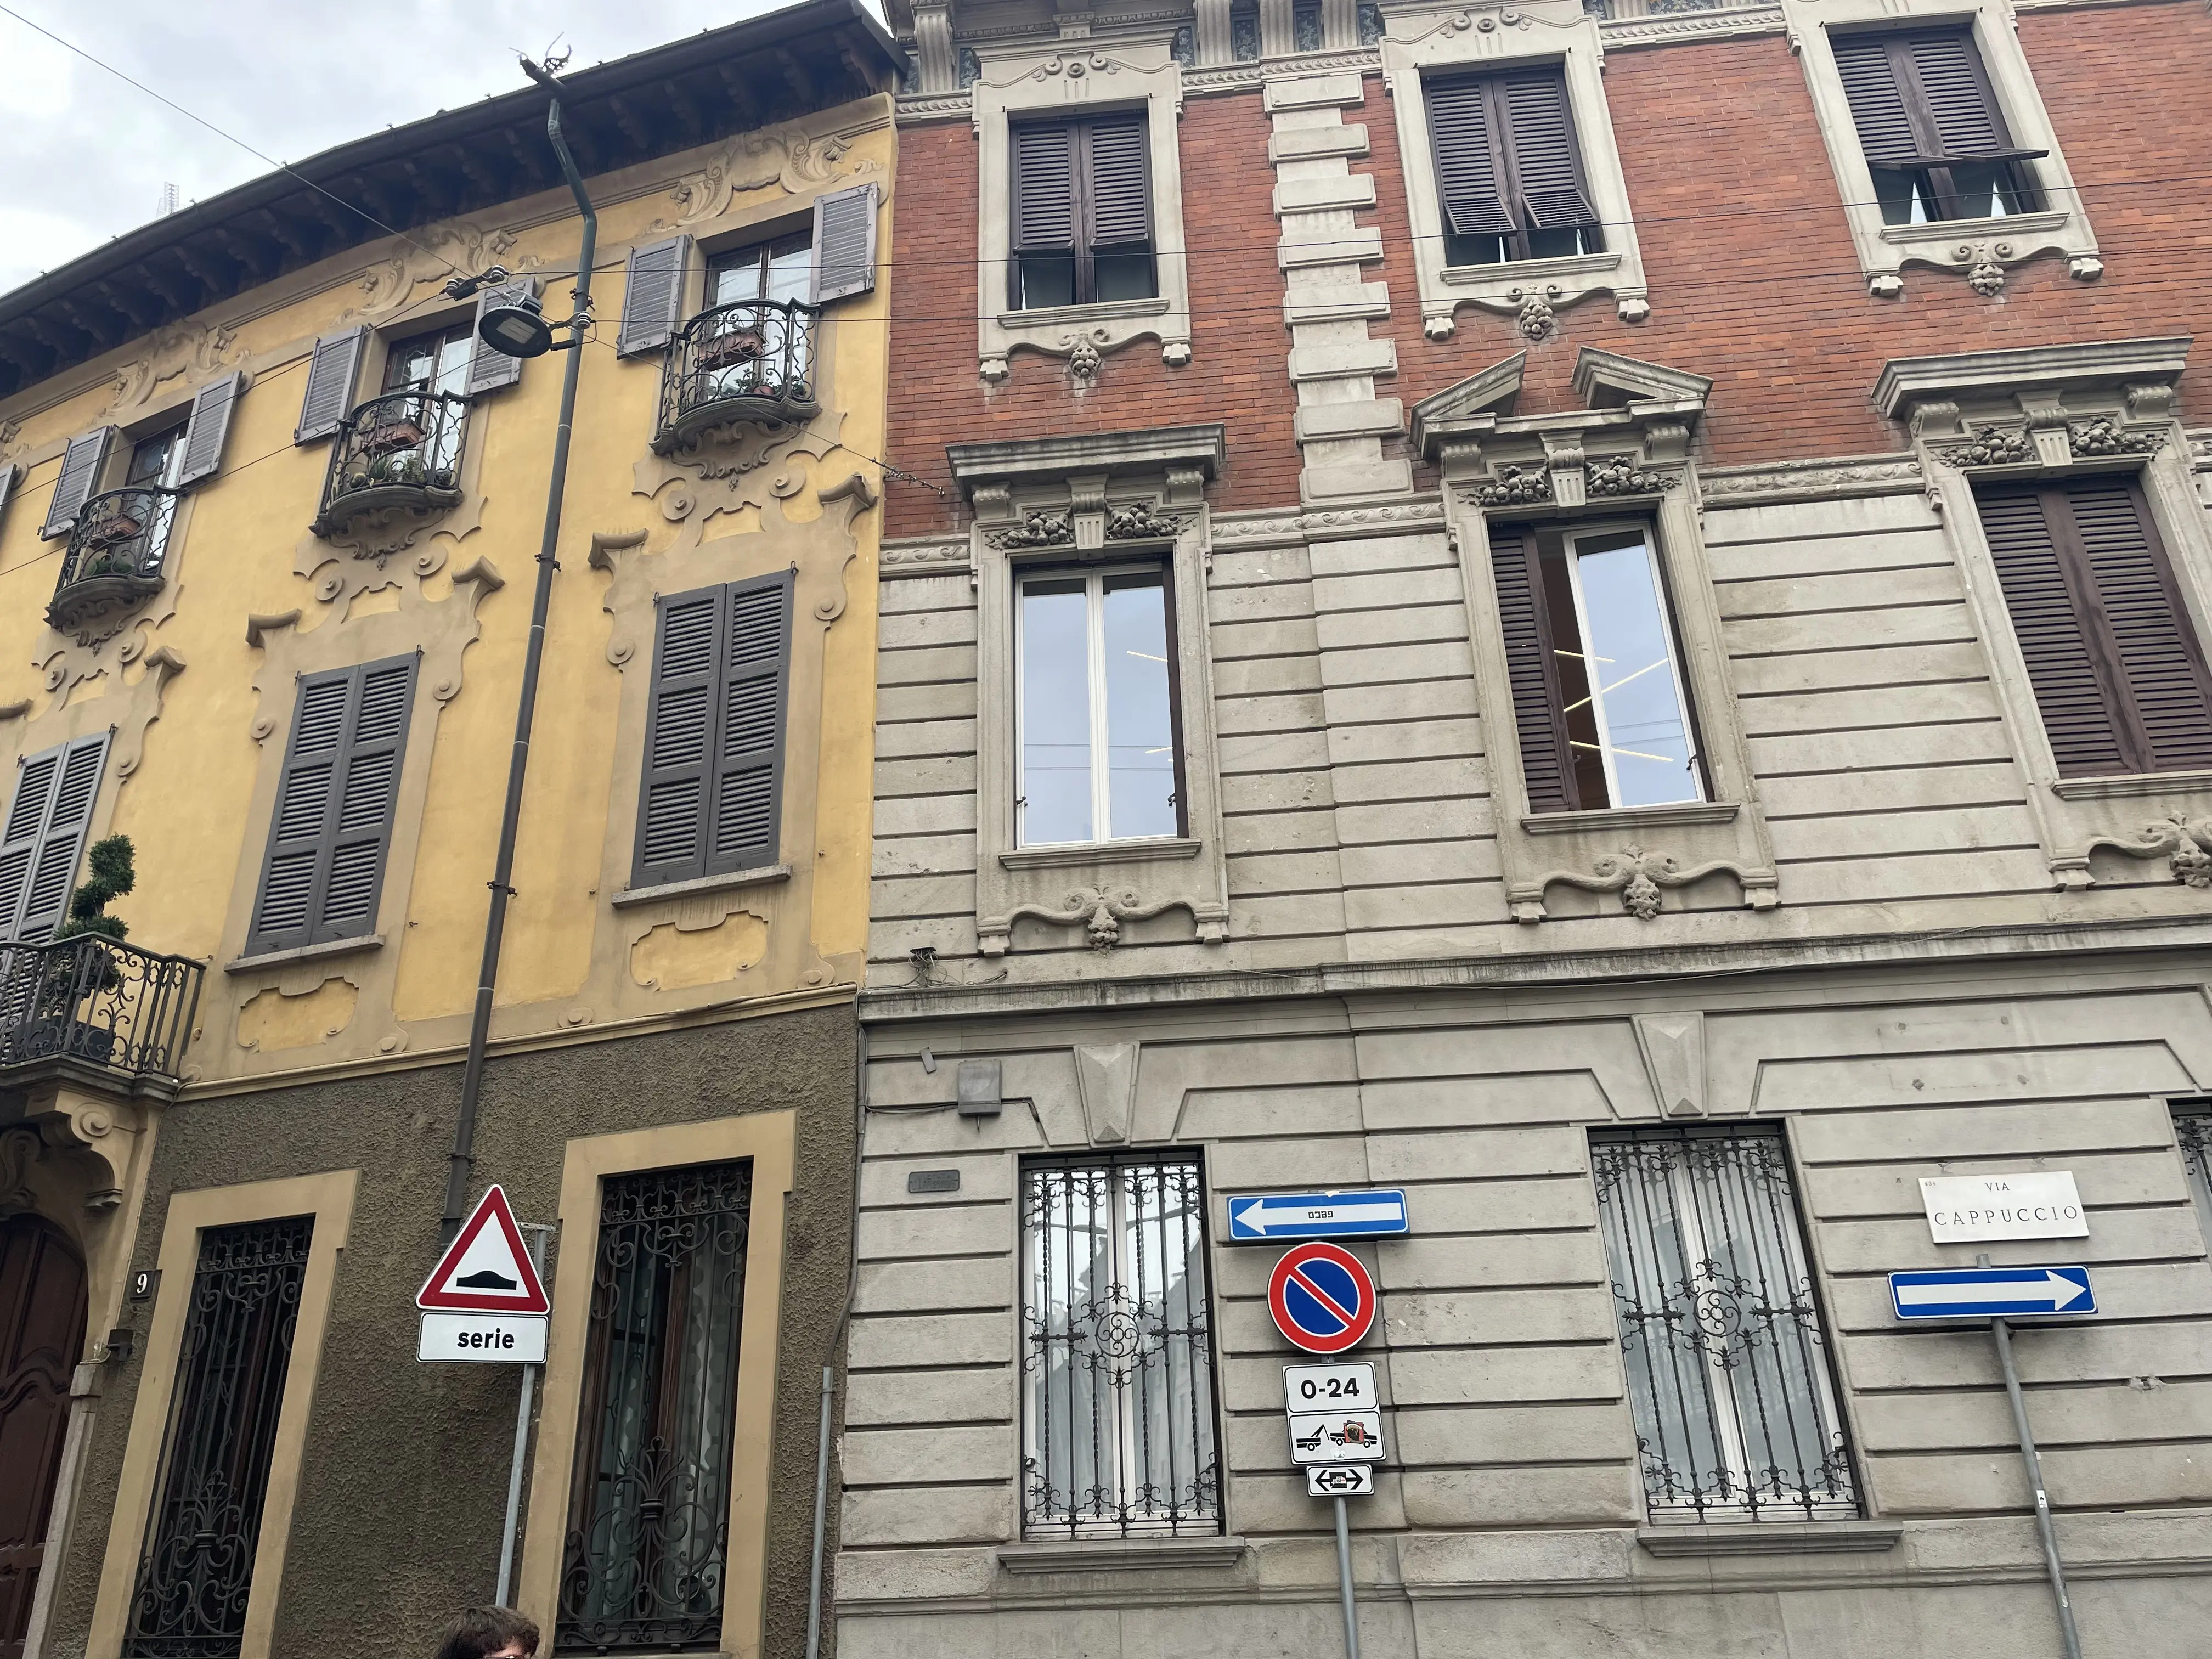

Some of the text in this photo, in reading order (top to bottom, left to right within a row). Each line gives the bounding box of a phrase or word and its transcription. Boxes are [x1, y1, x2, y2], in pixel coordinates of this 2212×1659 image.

[1985, 1182, 2010, 1191] VIA
[1934, 1206, 2077, 1226] CAPPUCCIO
[136, 1273, 148, 1294] 9
[457, 1328, 515, 1349] serie
[1301, 1377, 1360, 1400] 0-24
